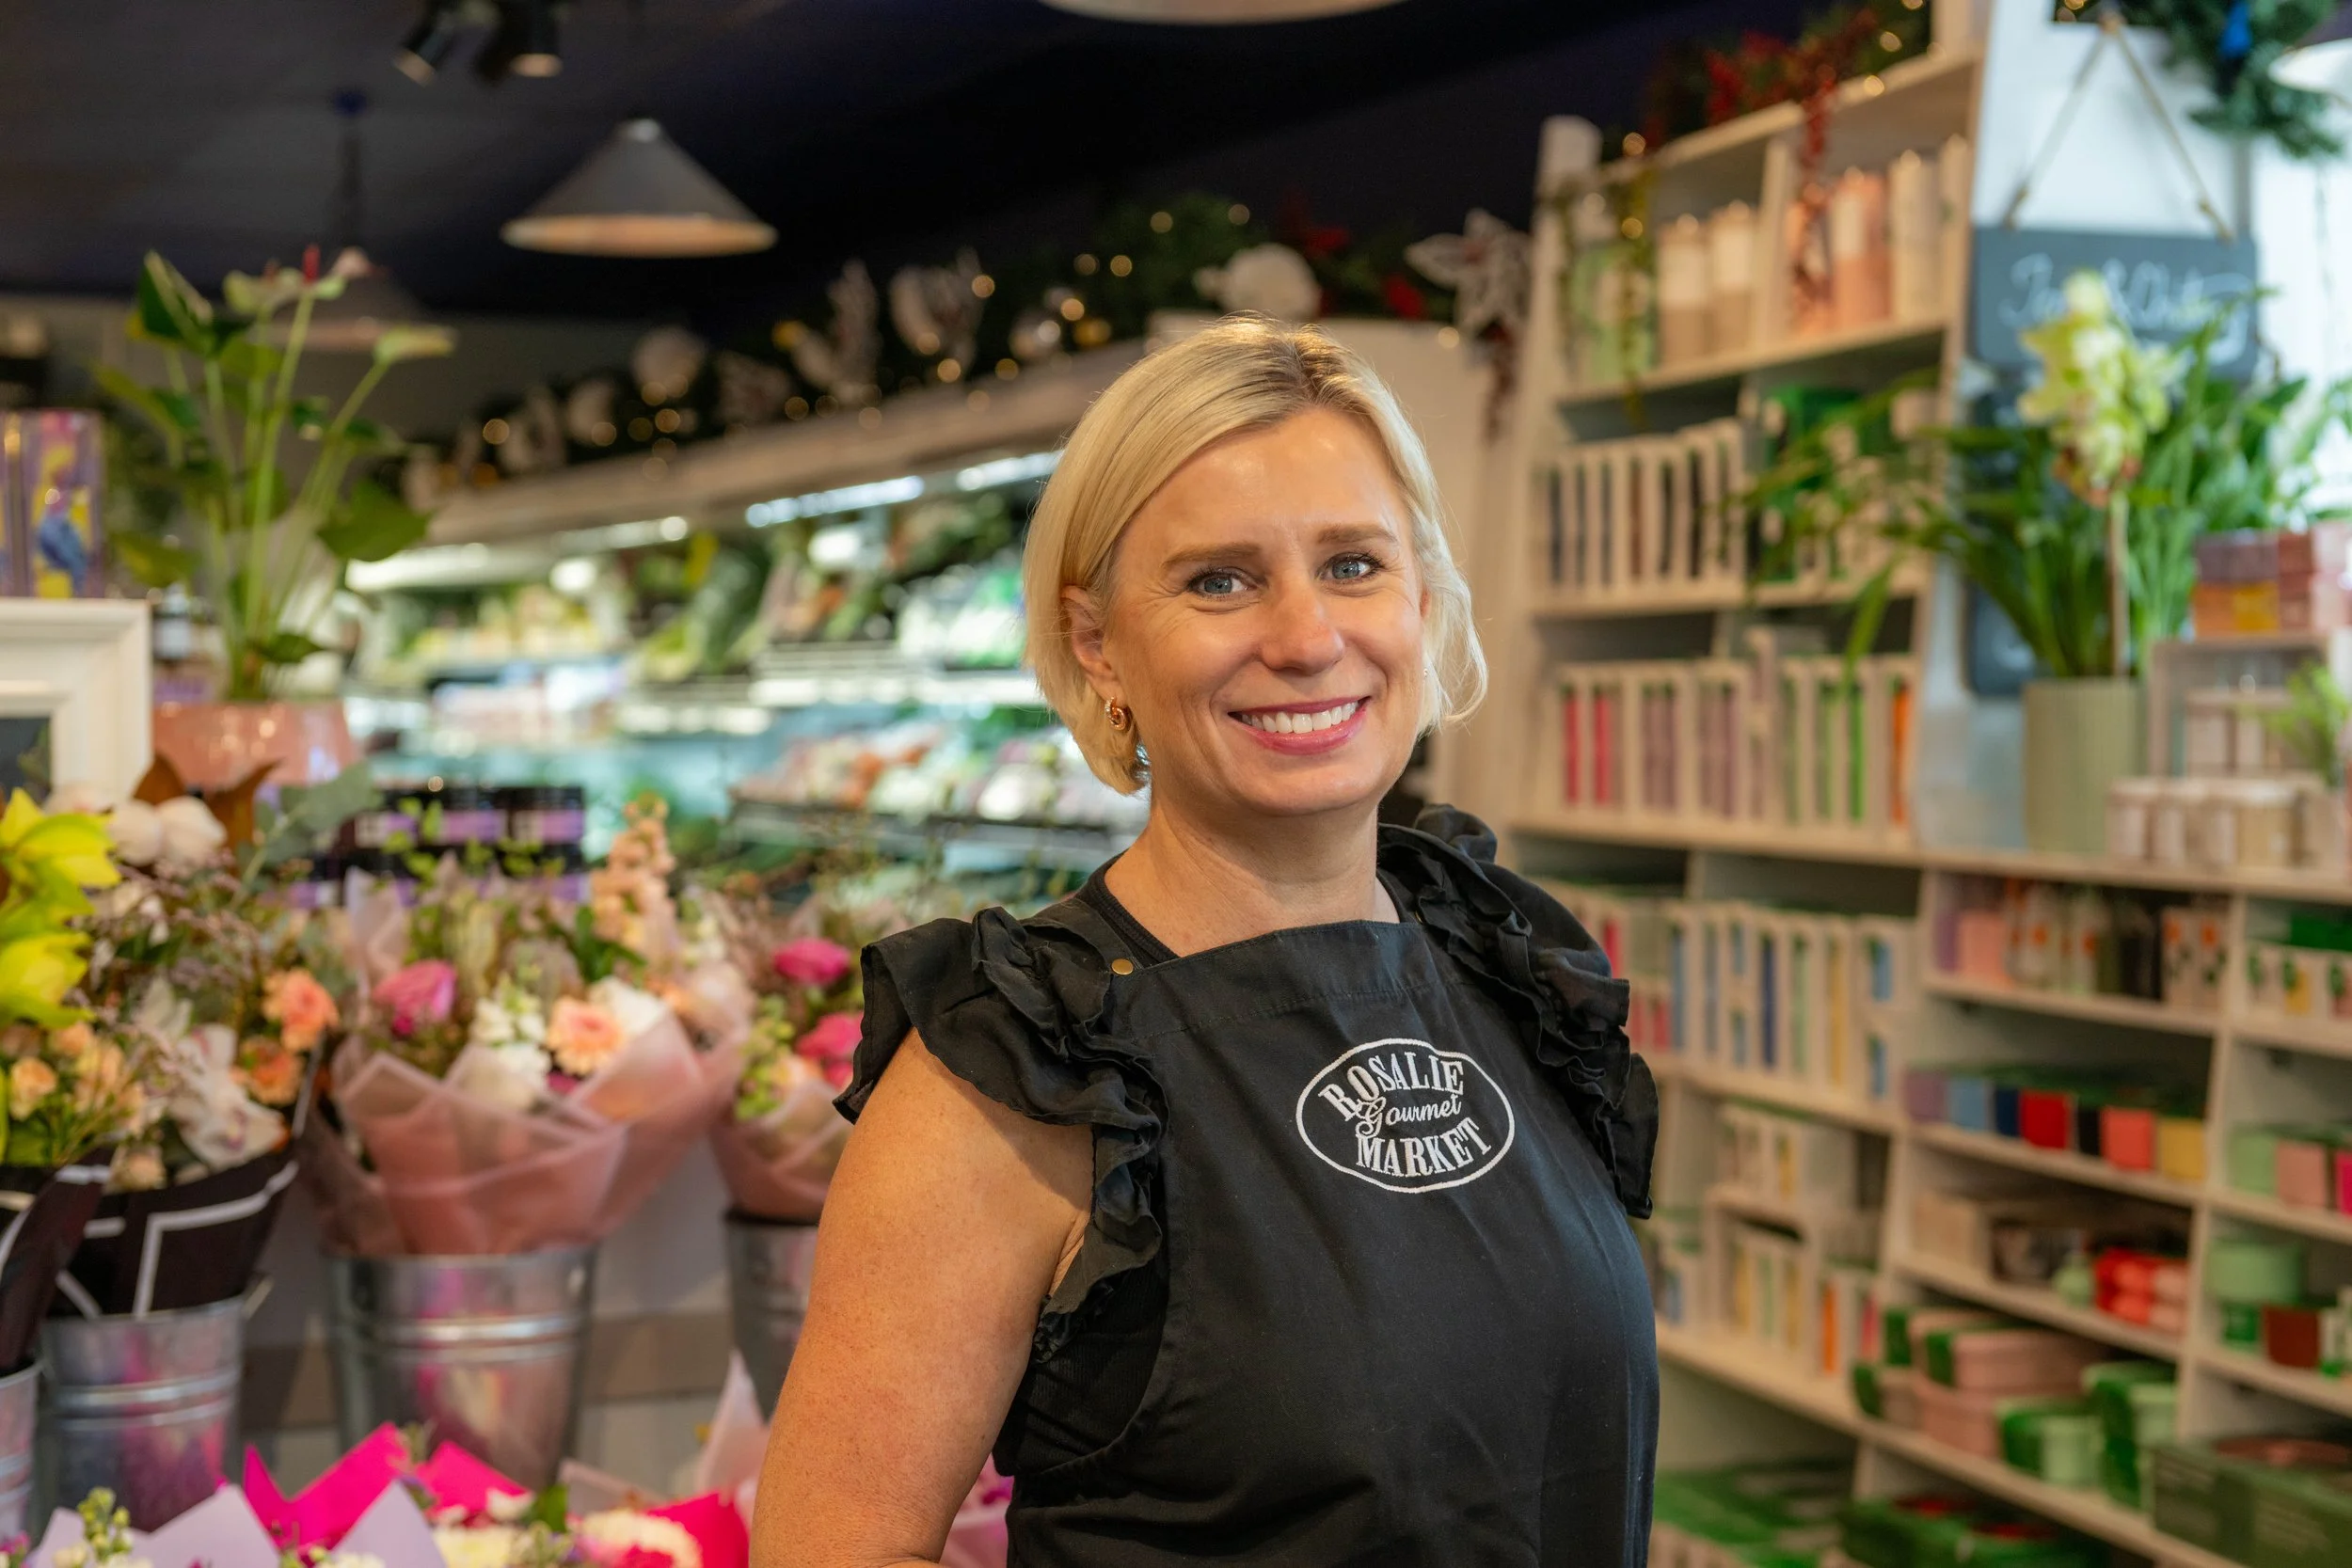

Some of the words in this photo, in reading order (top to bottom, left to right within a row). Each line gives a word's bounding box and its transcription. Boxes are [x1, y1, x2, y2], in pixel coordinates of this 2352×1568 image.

[1318, 1052, 1464, 1121] ROSALIE
[1355, 1093, 1462, 1138] Gourmet
[1356, 1117, 1492, 1178] MARKET
